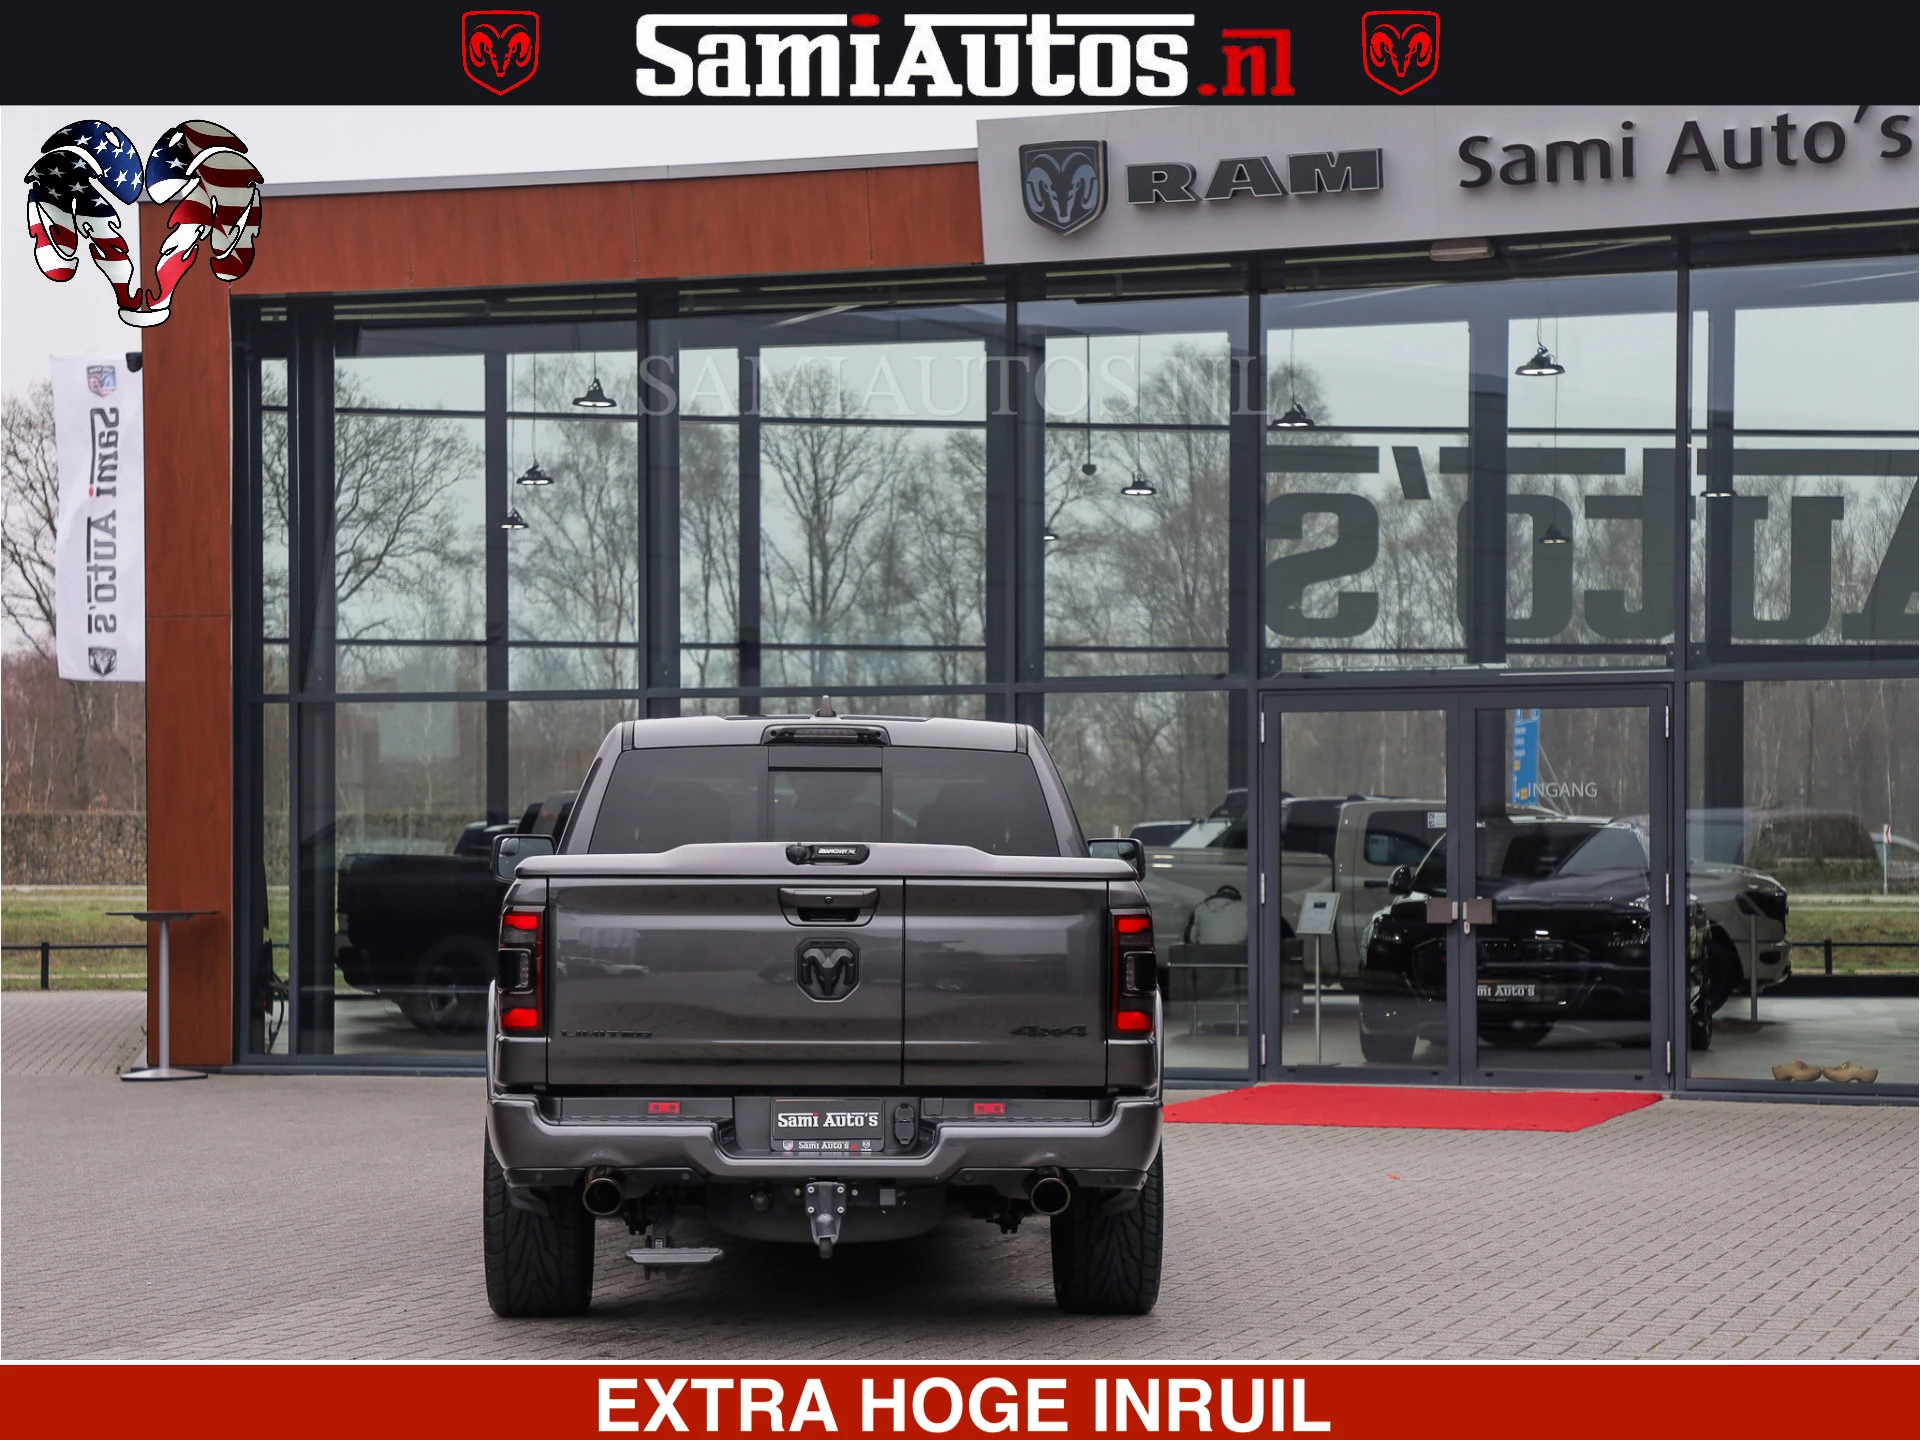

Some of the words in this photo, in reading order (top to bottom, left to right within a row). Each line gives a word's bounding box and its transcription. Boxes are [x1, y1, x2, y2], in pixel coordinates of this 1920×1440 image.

[1458, 120, 1636, 188] Sami
[1666, 105, 1913, 175] Auto's
[1126, 148, 1384, 205] RAM
[1527, 781, 1598, 798] INGANG
[561, 1029, 653, 1038] LIMITED
[777, 1111, 819, 1128] Sami
[822, 1112, 879, 1127] Auto's
[798, 1141, 819, 1150] Sami
